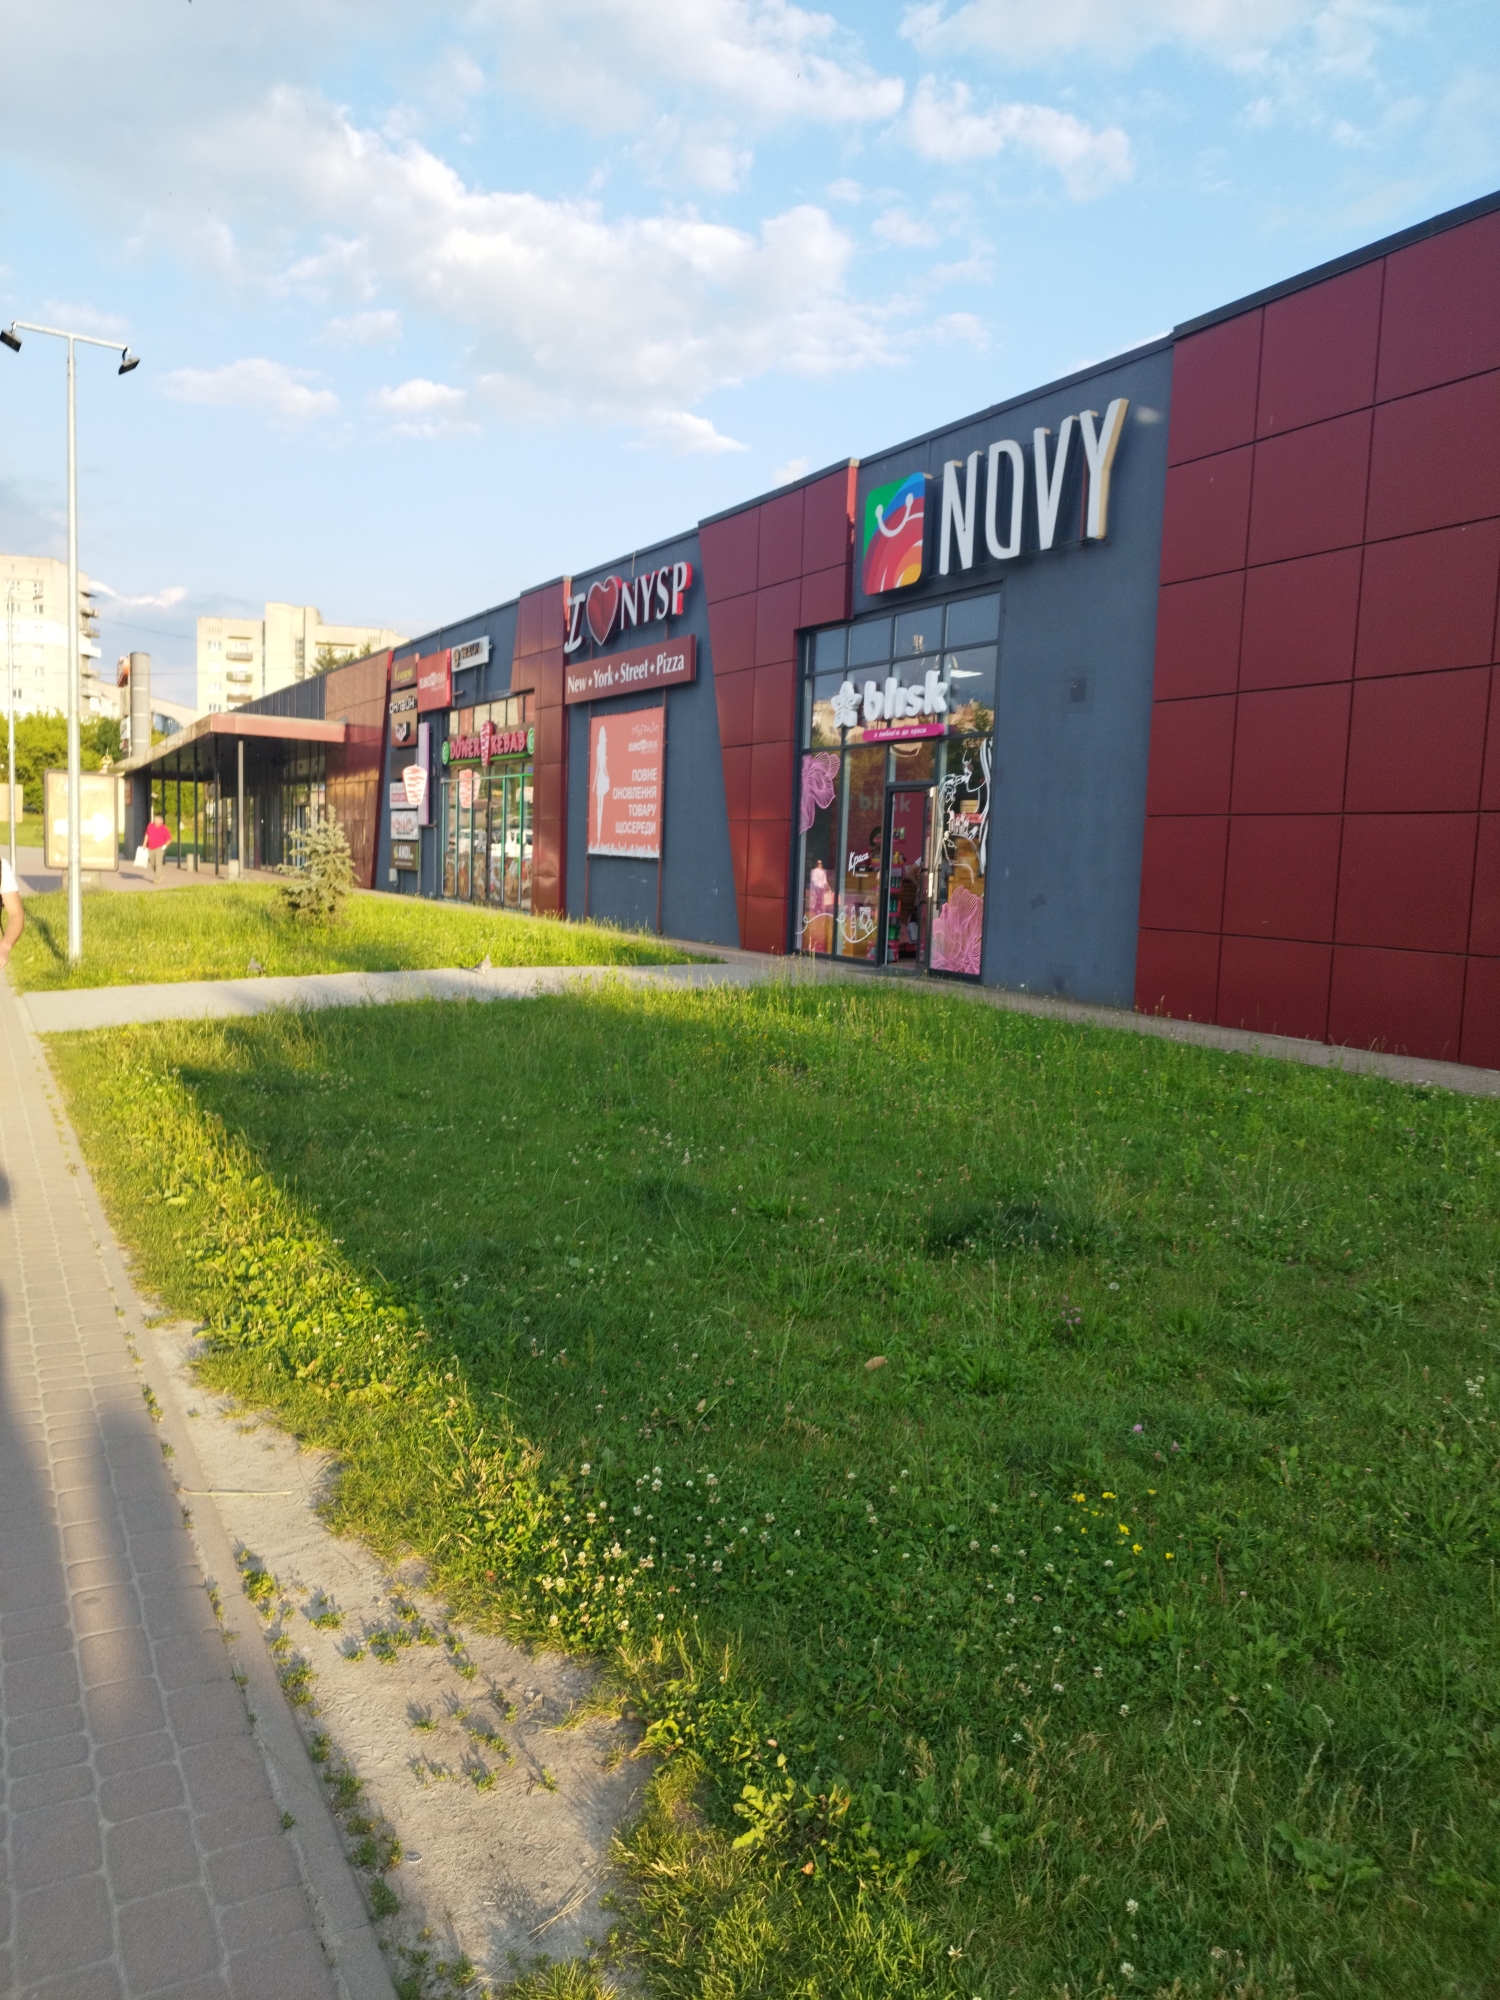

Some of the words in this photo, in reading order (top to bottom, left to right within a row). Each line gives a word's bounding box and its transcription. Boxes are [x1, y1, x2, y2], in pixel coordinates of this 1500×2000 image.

[939, 398, 1128, 576] NOVY
[620, 561, 693, 631] NYSP
[567, 675, 587, 694] New
[593, 664, 614, 689] York
[620, 659, 648, 683] Street
[656, 652, 684, 675] Pizza
[863, 670, 948, 722] blisk
[450, 735, 481, 760] DÖNER
[491, 730, 526, 755] KEBAB
[631, 768, 657, 782] ПОВНЕ
[613, 786, 657, 800] ОНОВЛЕННЯ
[628, 804, 657, 817] ТОВАРУ
[615, 821, 656, 836] ЩОСЕРЕДИ
